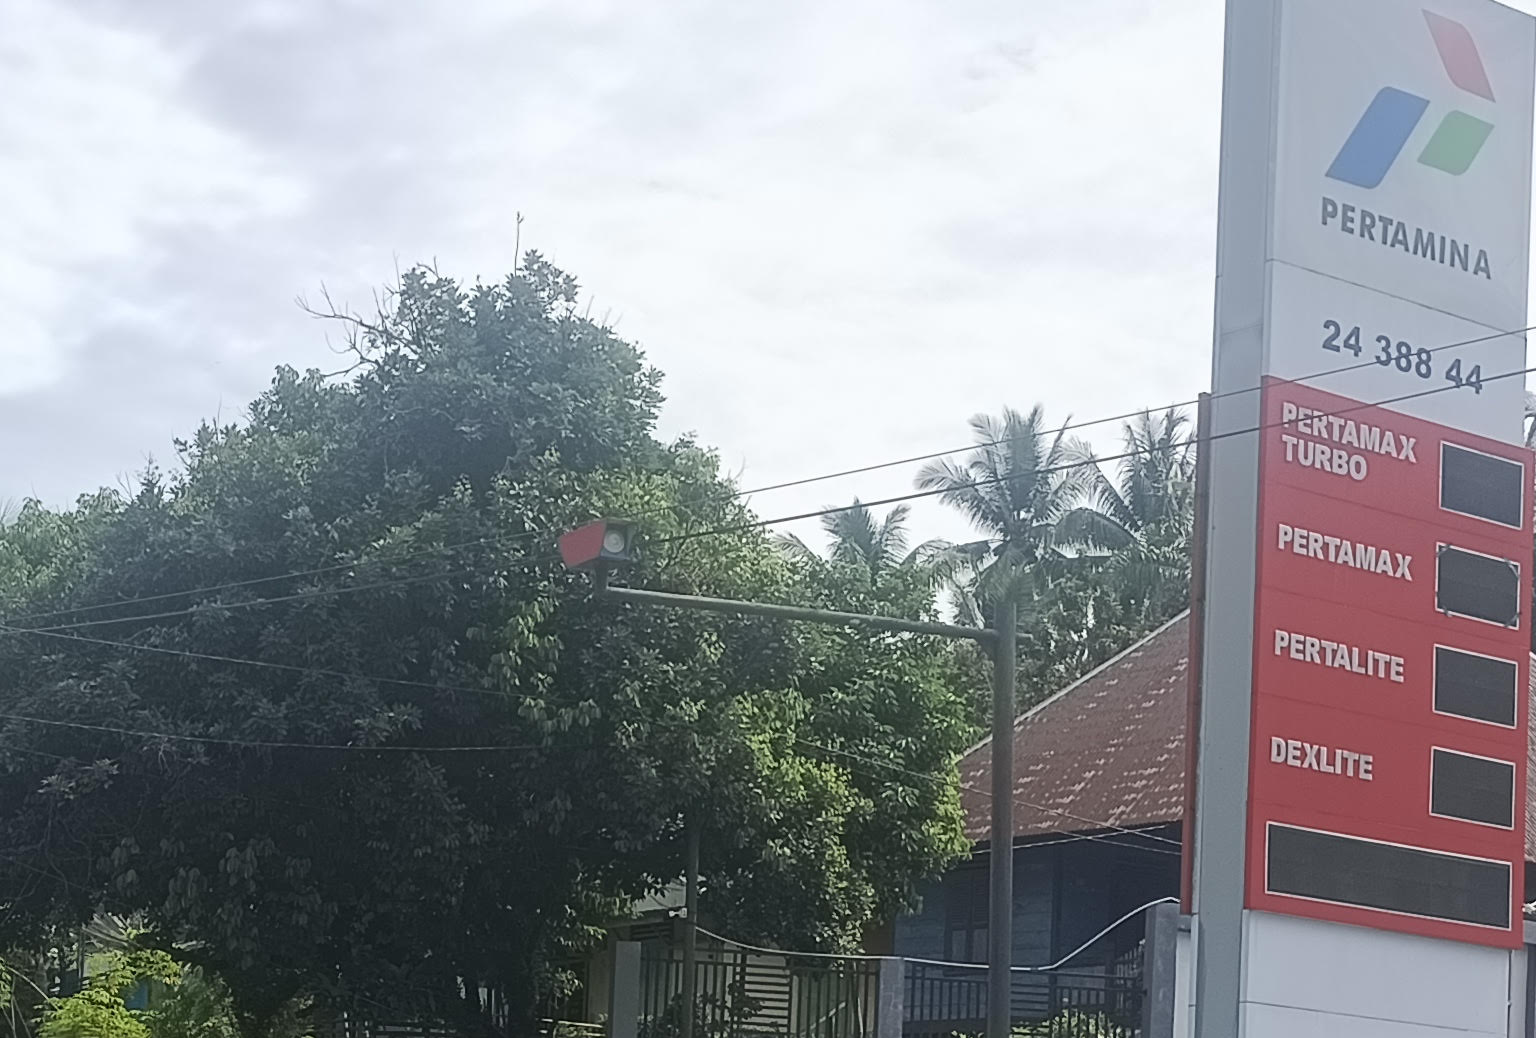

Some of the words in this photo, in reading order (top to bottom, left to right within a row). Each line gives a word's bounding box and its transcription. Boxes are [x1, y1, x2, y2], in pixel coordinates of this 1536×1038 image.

[1320, 196, 1492, 280] PERTAMINA
[1321, 319, 1362, 357] 24
[1375, 334, 1432, 380] 388
[1445, 358, 1483, 395] 44
[1281, 401, 1418, 464] PERTAMAX
[1281, 434, 1368, 481] TURBO
[1277, 522, 1414, 582] PERTAMAX
[1273, 628, 1405, 684] PERTALITE
[1270, 736, 1373, 781] DEXLITE
